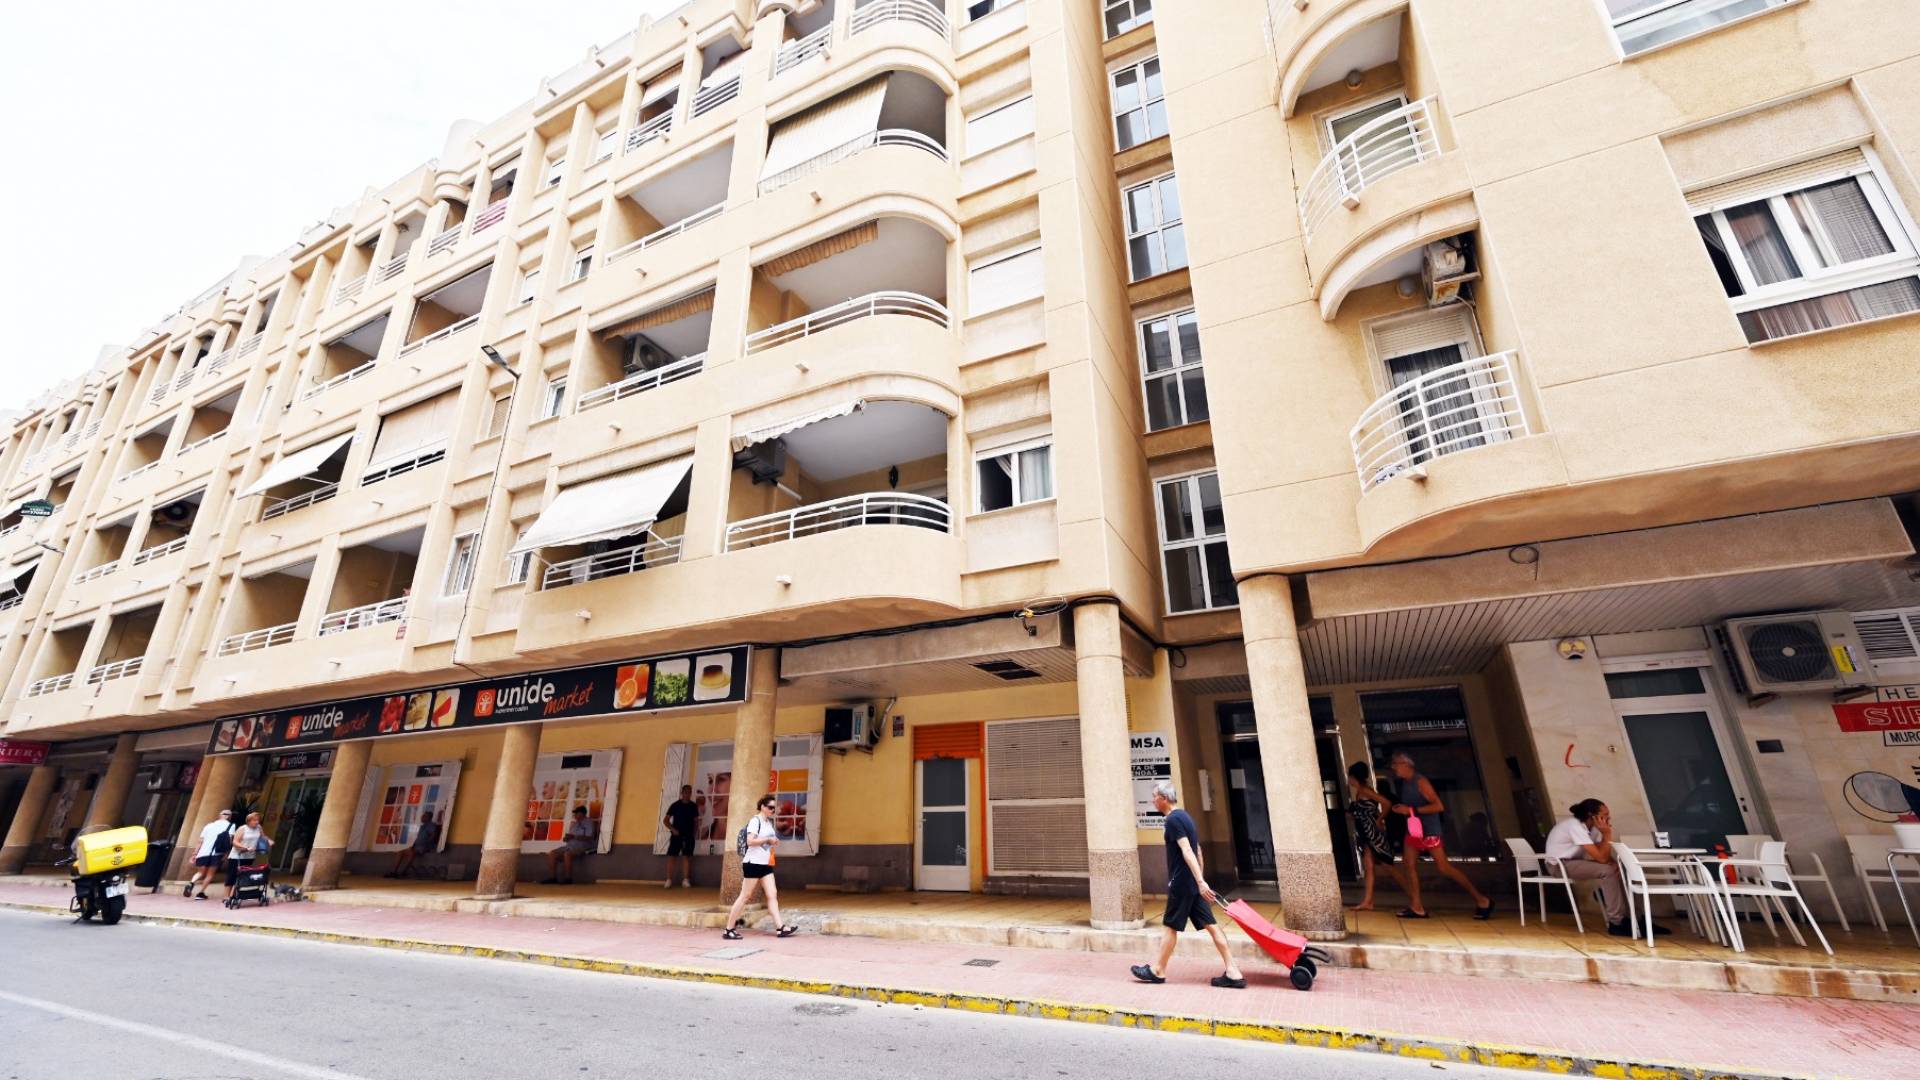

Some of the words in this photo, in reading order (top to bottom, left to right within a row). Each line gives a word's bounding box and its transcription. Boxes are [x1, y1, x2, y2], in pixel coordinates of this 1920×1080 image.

[496, 678, 555, 707] unide
[543, 681, 595, 716] market
[302, 706, 344, 731] unide
